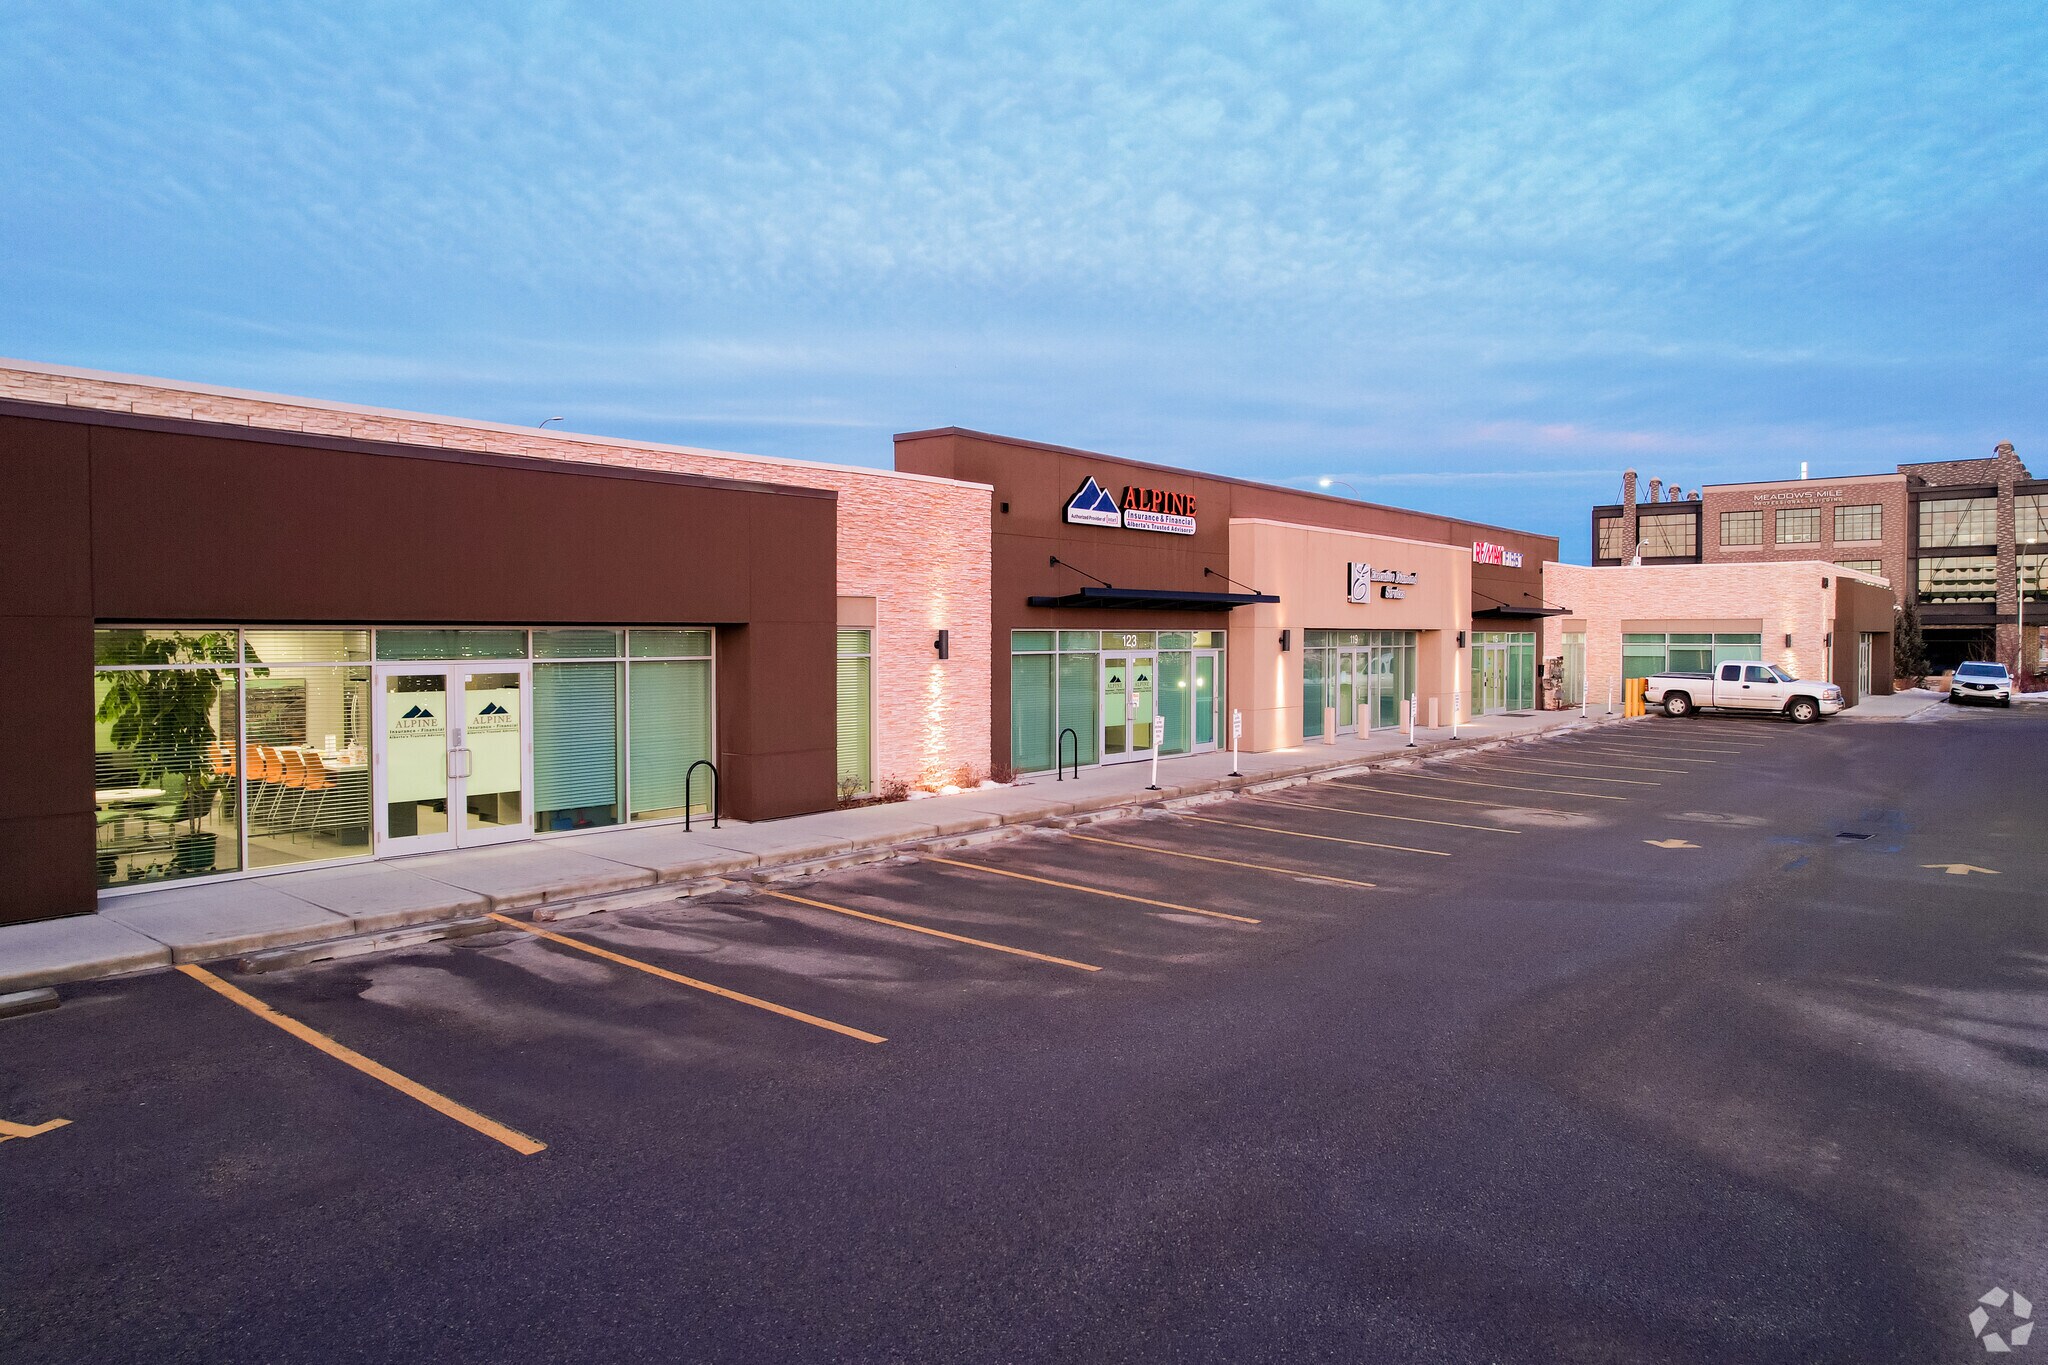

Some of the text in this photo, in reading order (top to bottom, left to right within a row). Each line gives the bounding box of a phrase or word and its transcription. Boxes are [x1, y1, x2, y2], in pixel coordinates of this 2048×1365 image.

[1753, 489, 1843, 501] MEADOWS MILE
[1124, 486, 1198, 517] ALPINE
[1071, 513, 1089, 521] Authorized
[1128, 511, 1193, 526] Insurance & Financial
[1127, 521, 1150, 529] Alberta's
[1504, 551, 1523, 568] FIRST
[1122, 634, 1137, 647] 123
[1350, 634, 1359, 644] 119
[395, 718, 438, 729] ALPINE
[473, 714, 512, 725] ALPINE
